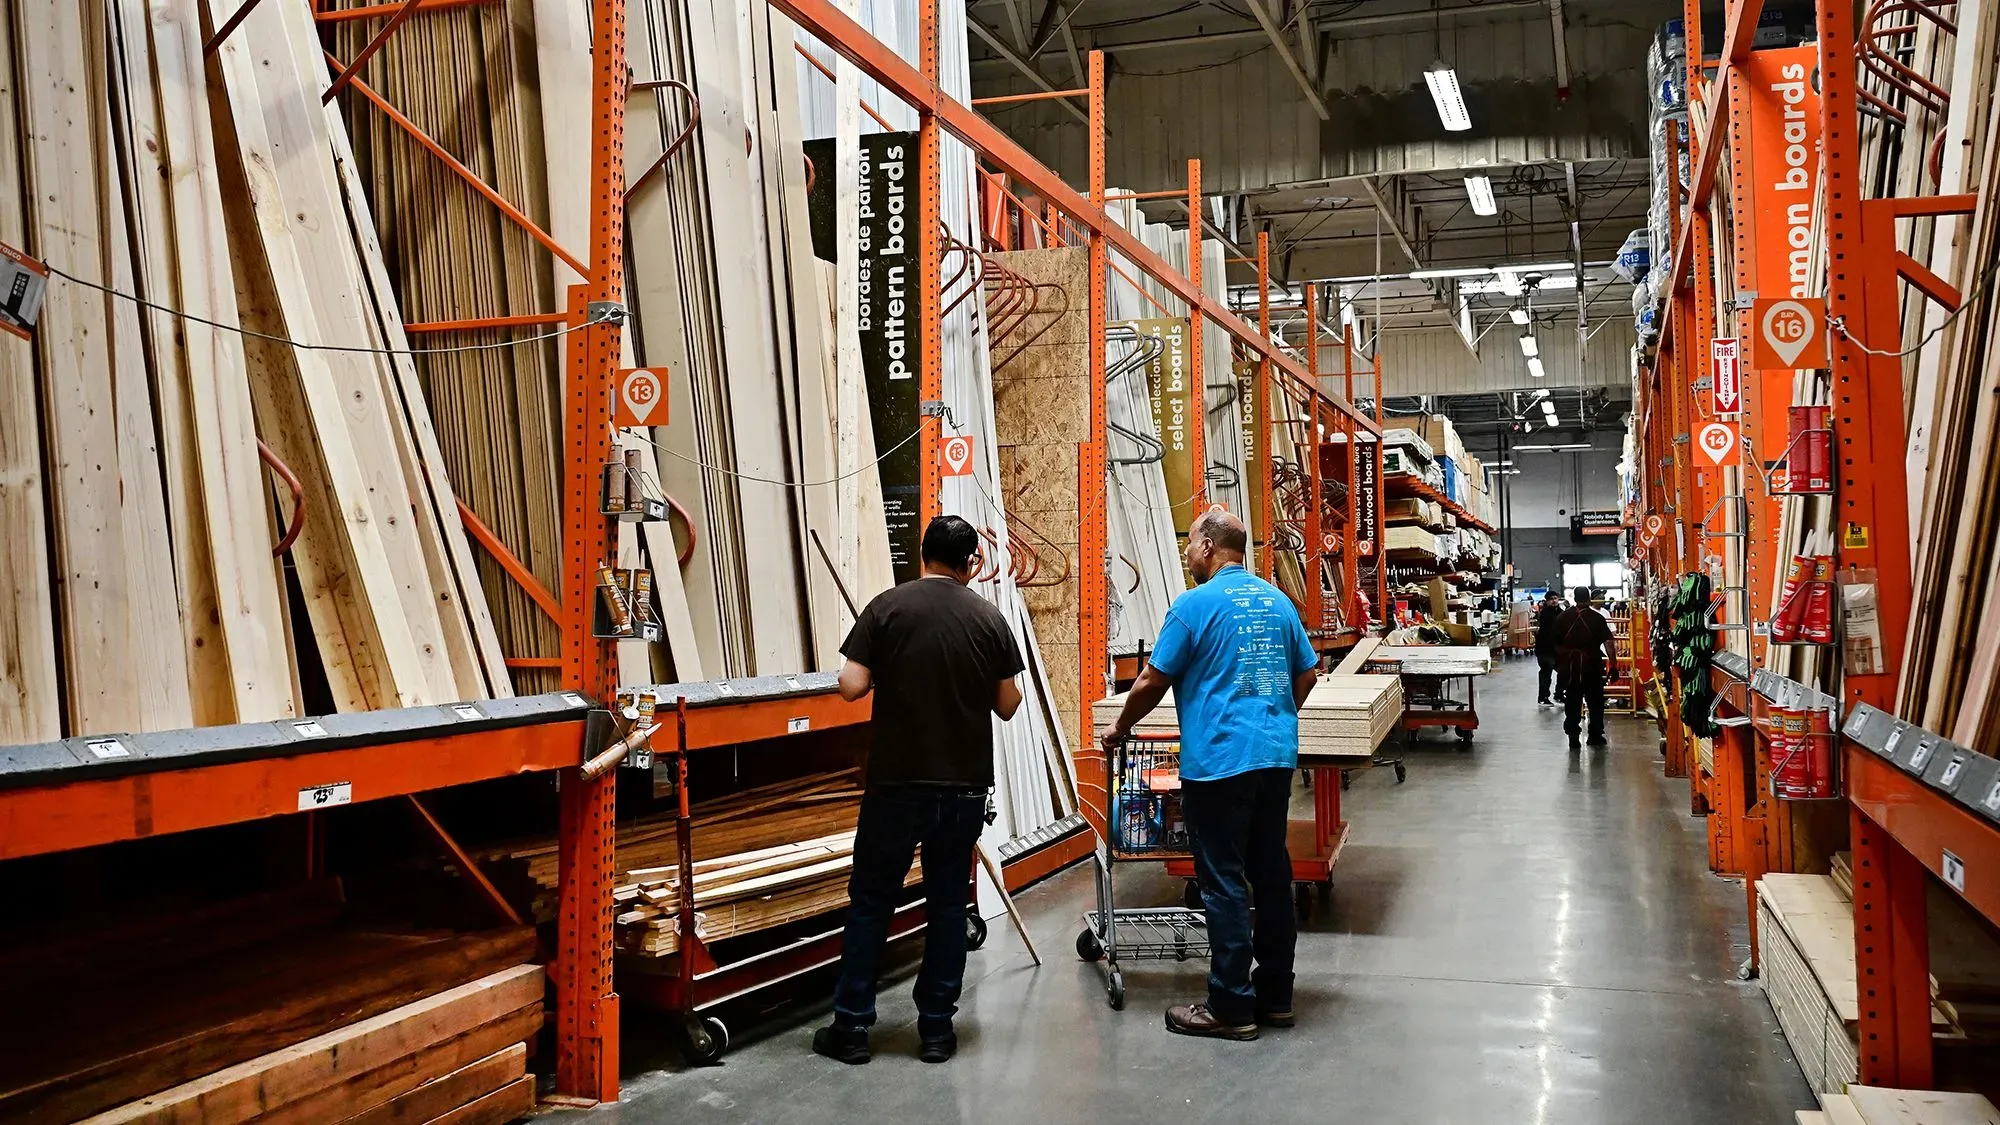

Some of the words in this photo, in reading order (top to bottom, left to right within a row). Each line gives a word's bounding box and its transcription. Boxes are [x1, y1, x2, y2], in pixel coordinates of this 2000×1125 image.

[1771, 63, 1808, 190] boards
[879, 145, 904, 255] boards
[1624, 254, 1640, 264] R13
[885, 266, 913, 380] pattern
[1775, 319, 1803, 338] 16
[1166, 324, 1182, 392] boards
[1716, 346, 1734, 357] FIRE
[632, 385, 652, 401] 13
[1239, 368, 1253, 424] boards
[1167, 398, 1183, 451] select
[1708, 435, 1726, 447] 14
[951, 448, 964, 459] 13
[1362, 446, 1373, 488] boards
